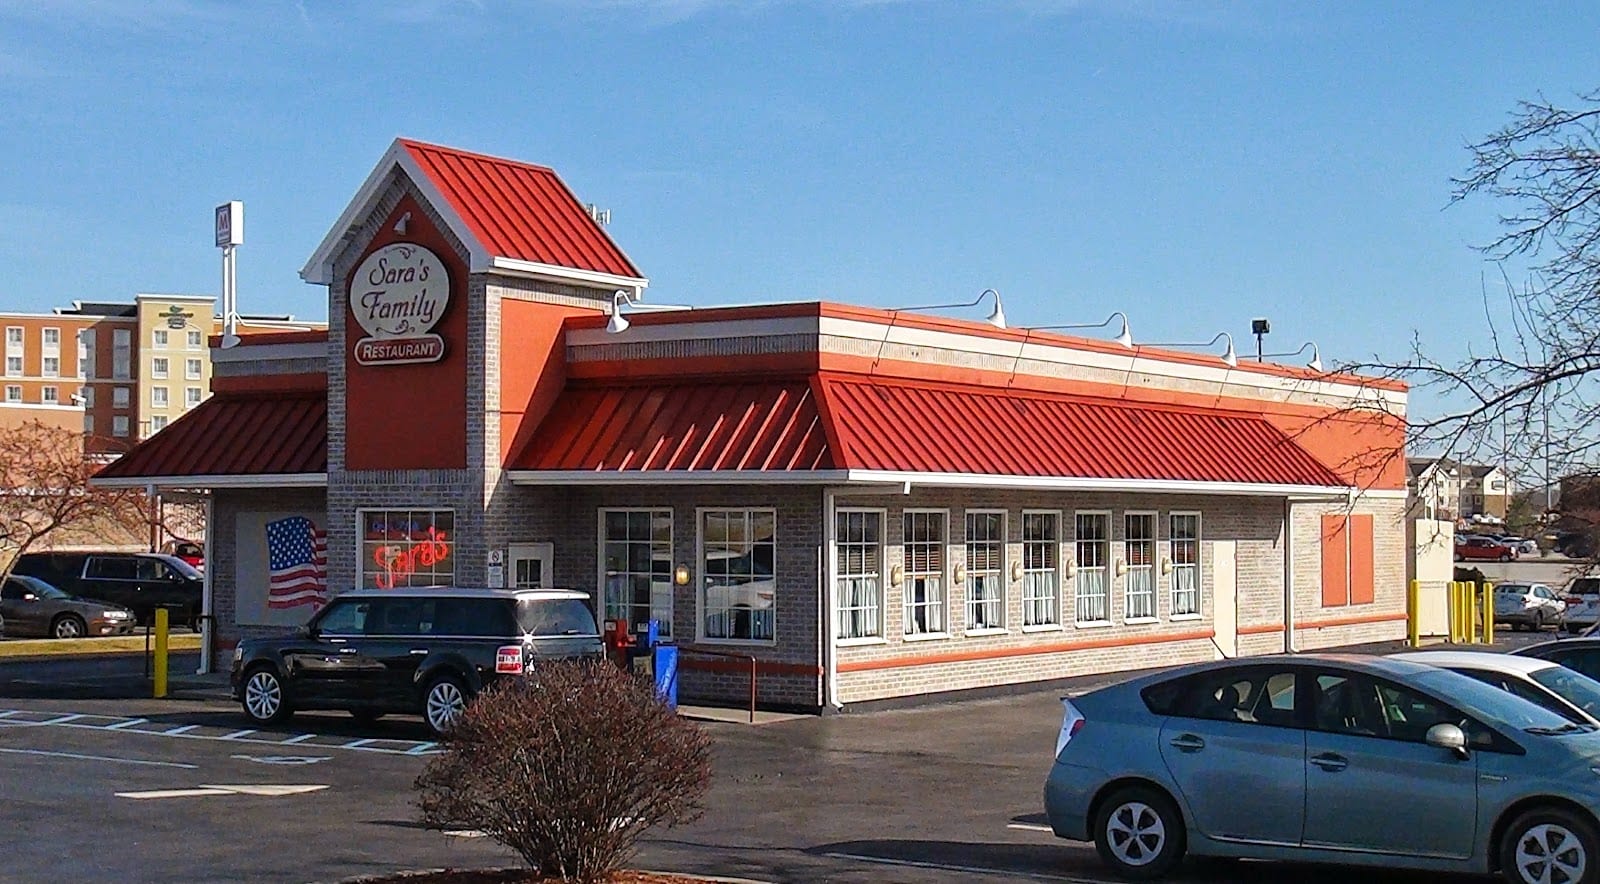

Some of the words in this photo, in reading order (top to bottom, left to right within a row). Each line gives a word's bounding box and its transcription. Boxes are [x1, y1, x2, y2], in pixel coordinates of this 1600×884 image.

[369, 258, 430, 286] Sara's
[361, 288, 436, 324] Family
[362, 343, 435, 359] RESTAURANT
